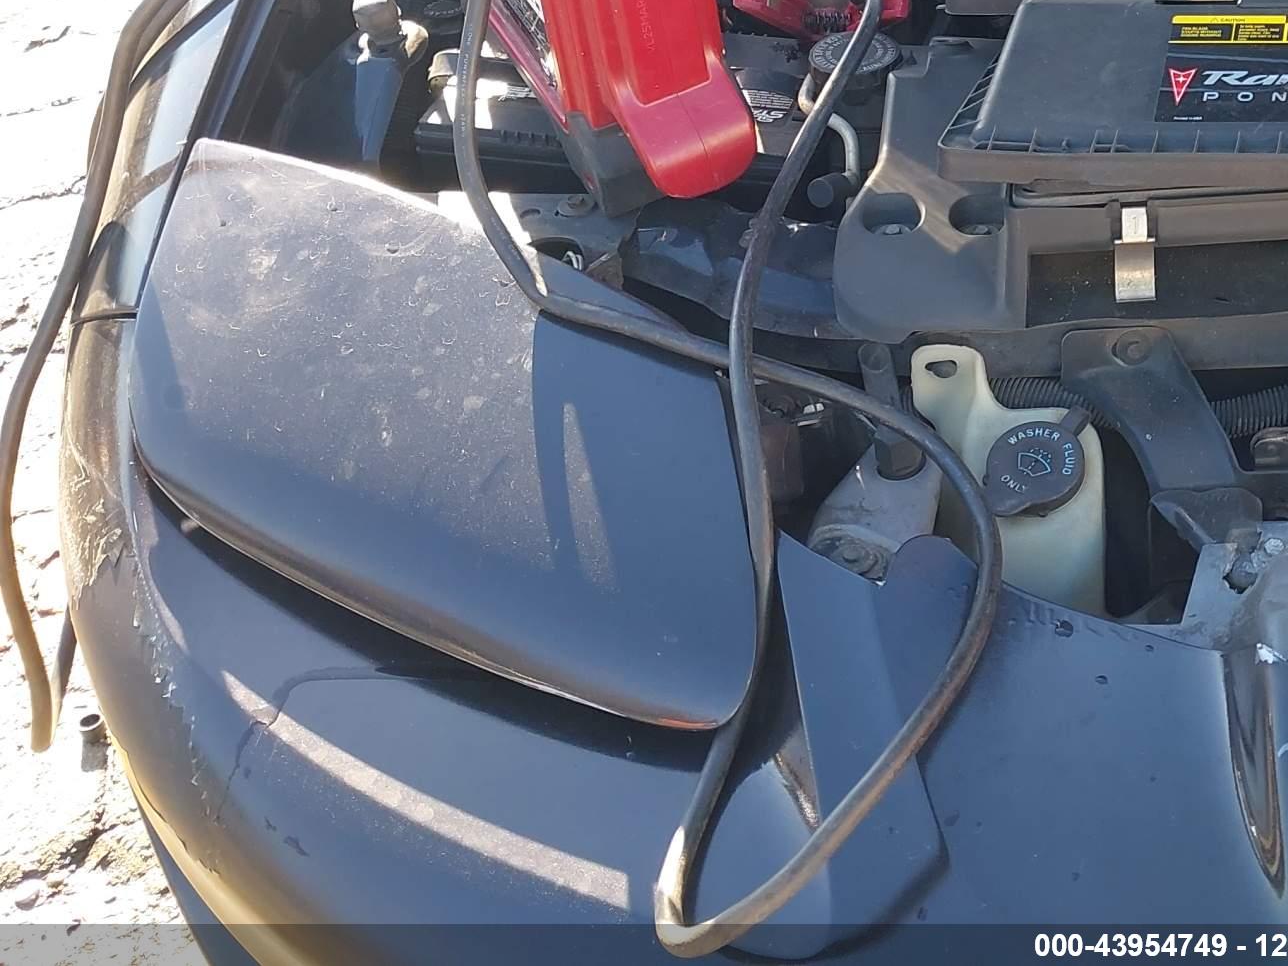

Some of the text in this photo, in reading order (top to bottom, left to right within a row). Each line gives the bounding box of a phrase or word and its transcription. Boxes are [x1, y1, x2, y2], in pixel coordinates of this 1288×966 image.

[1000, 428, 1075, 493] WASHER FLUID ONLY
